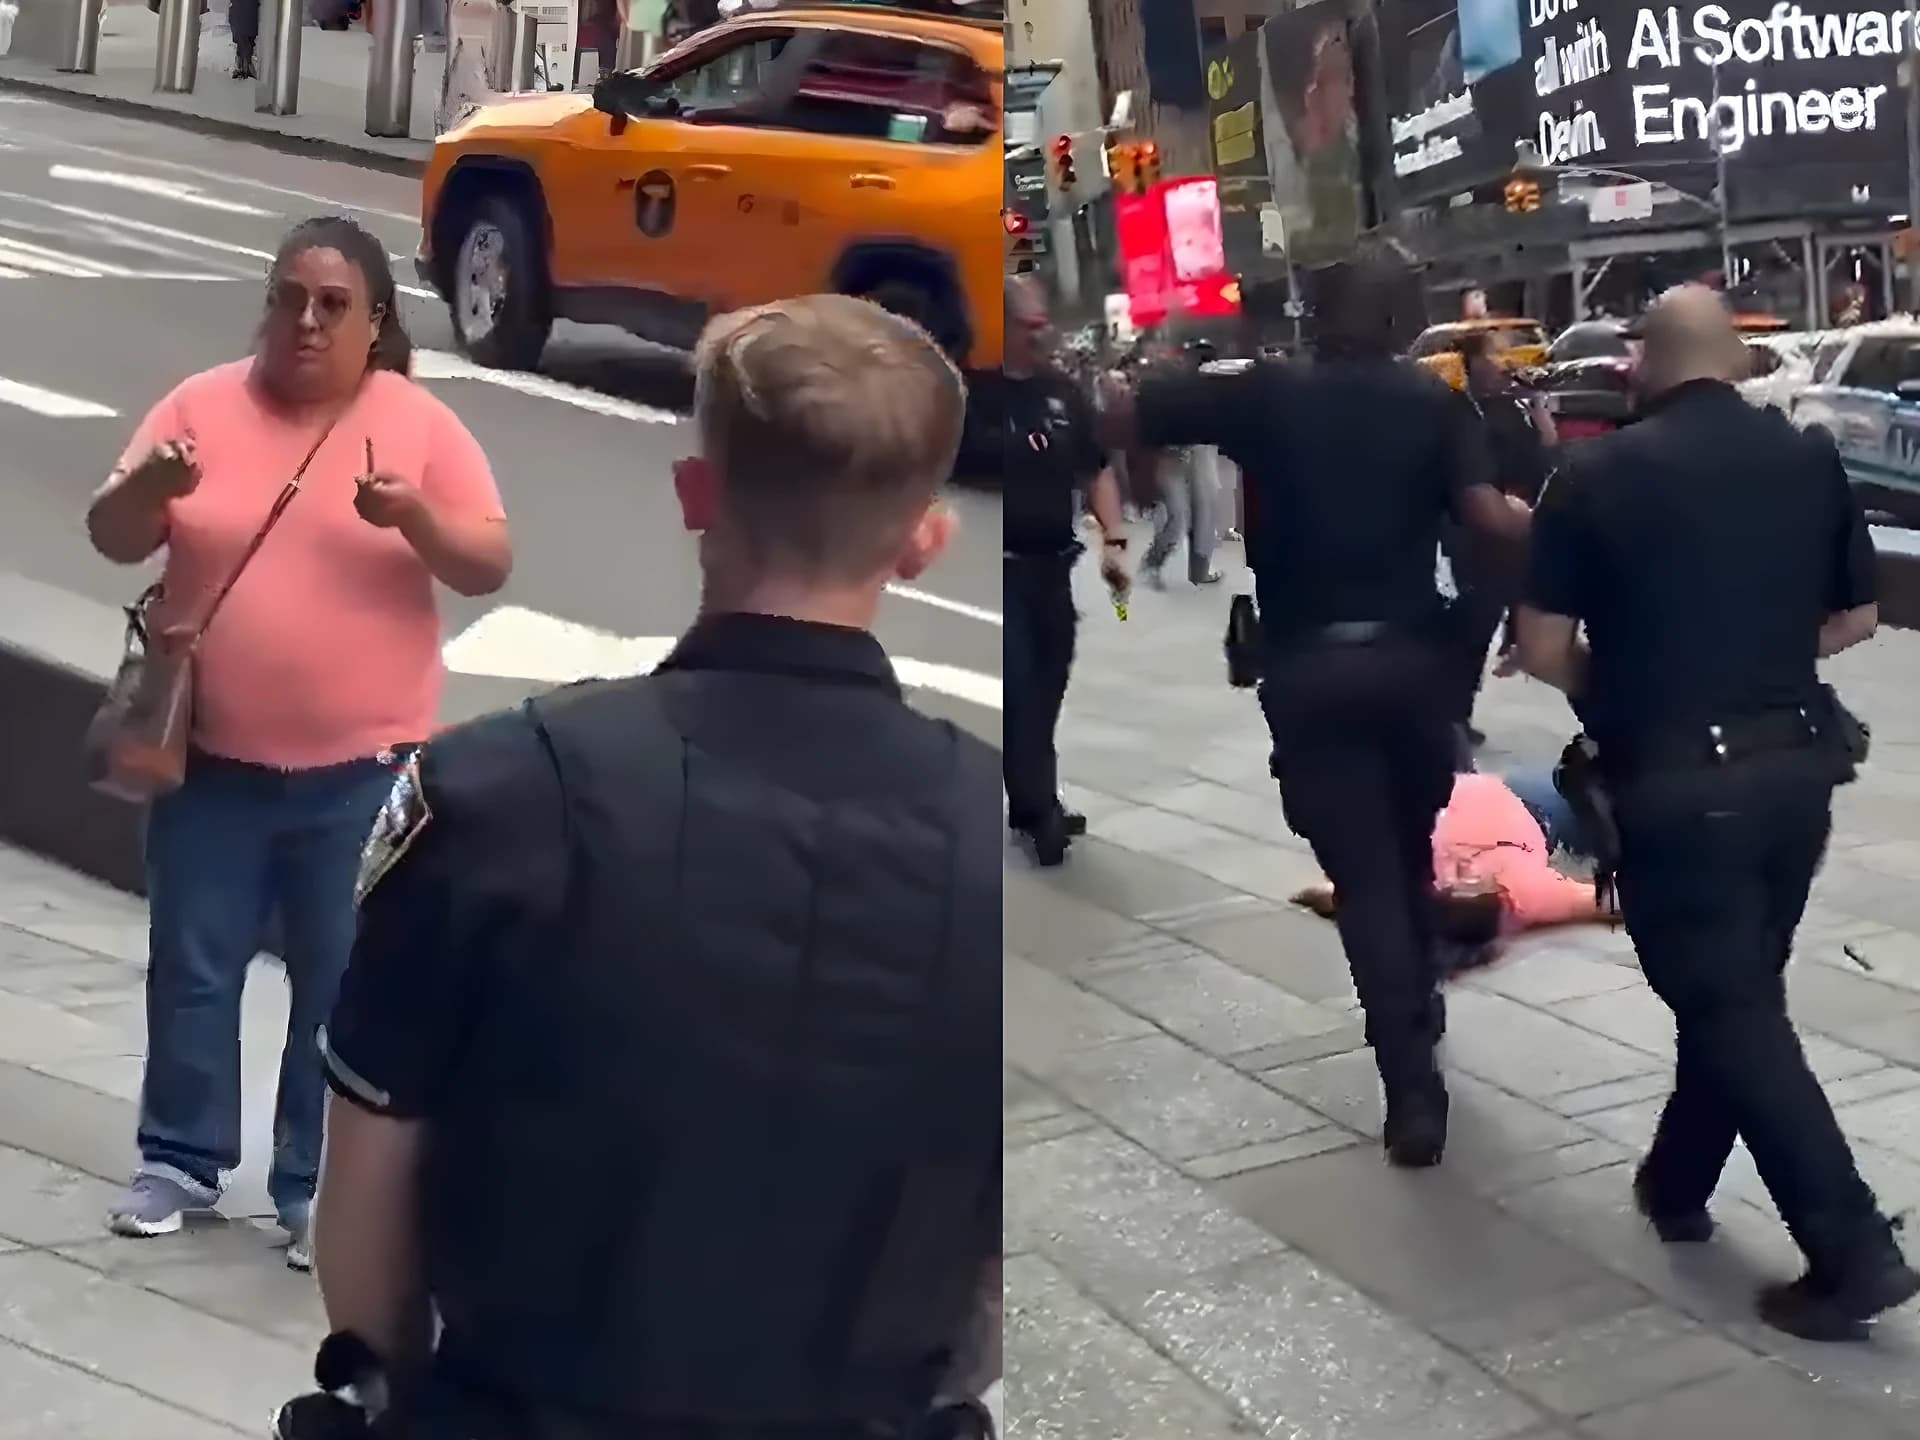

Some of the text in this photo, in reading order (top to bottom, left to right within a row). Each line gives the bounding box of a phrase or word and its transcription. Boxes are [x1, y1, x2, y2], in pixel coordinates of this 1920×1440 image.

[1627, 1, 1920, 69] AI Softwar
[1632, 79, 1887, 153] Engineer
